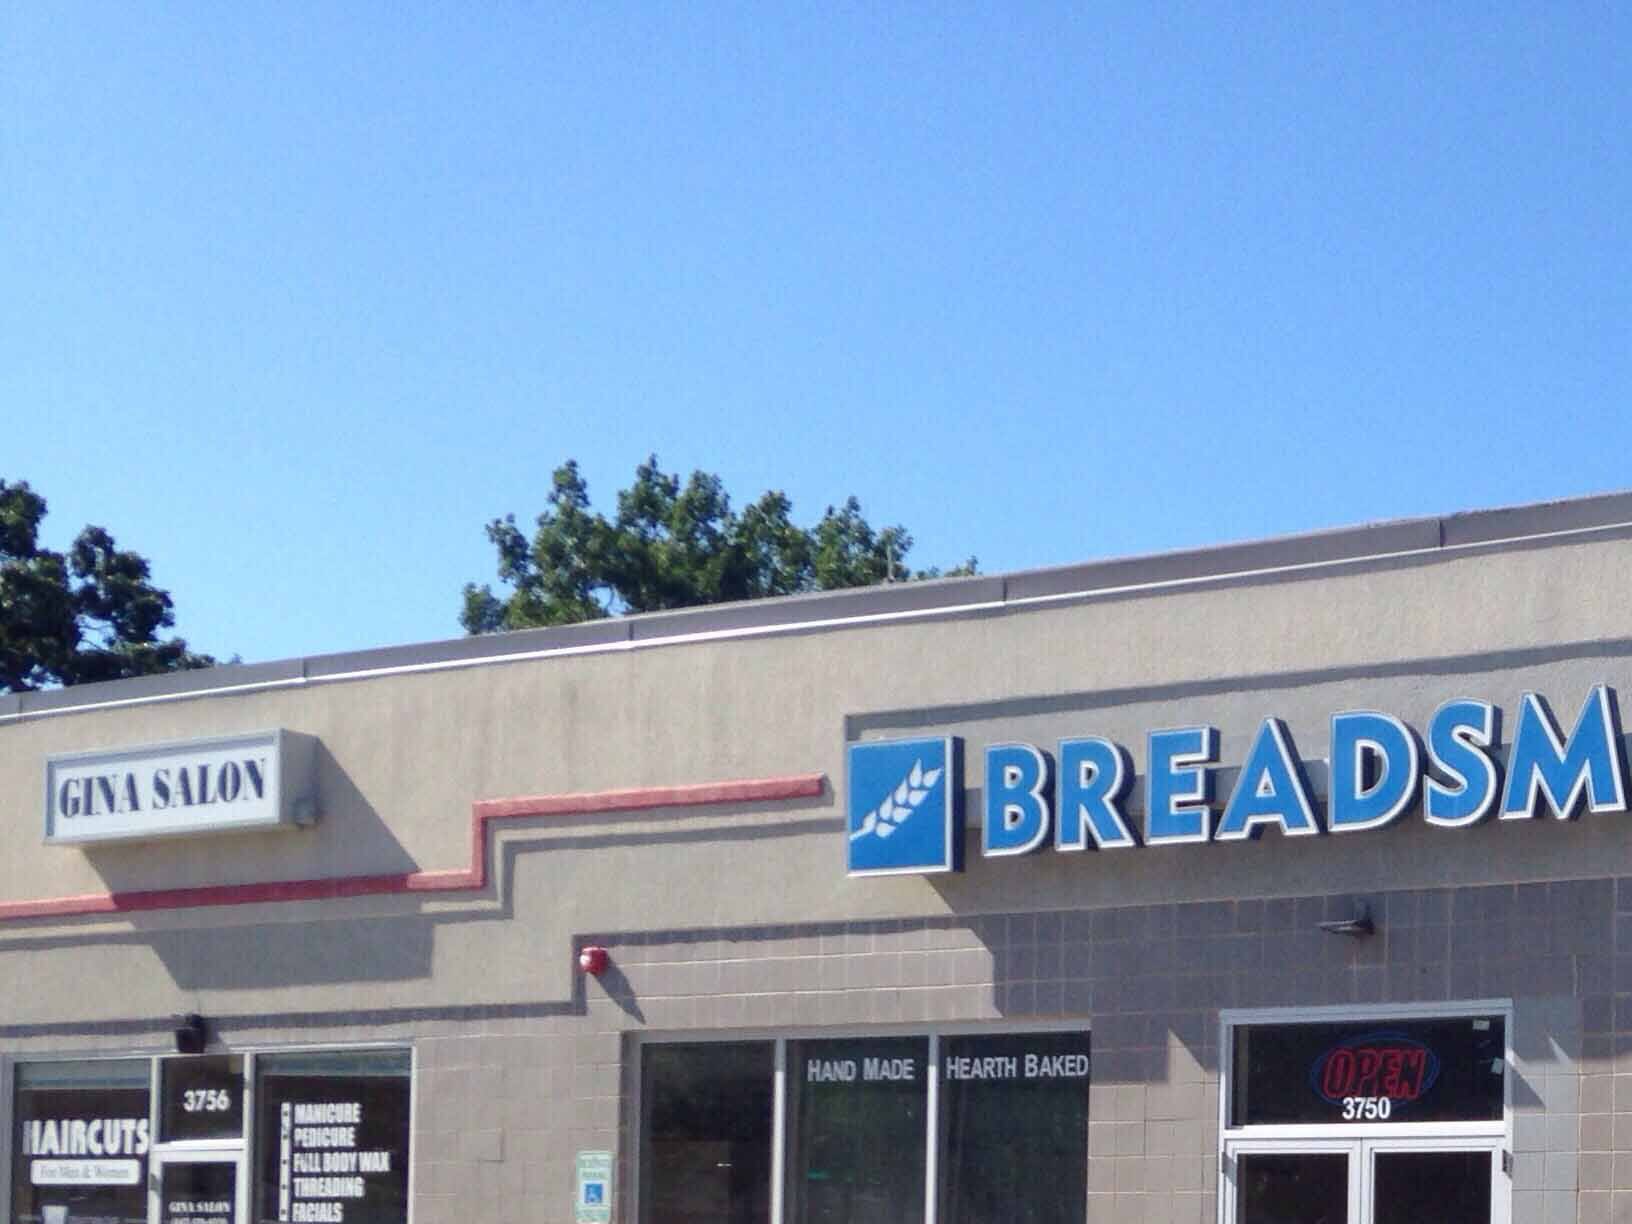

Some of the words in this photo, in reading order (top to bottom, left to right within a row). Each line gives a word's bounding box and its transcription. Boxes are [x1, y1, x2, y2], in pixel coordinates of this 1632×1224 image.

[59, 772, 140, 819] GINA
[152, 758, 266, 810] SALON
[807, 1059, 857, 1083] HAND
[863, 1057, 915, 1081] MADE
[946, 1056, 1017, 1080] HEARTH
[1024, 1054, 1090, 1078] BAKED
[1323, 1047, 1426, 1100] OPEN
[183, 1089, 231, 1113] 3756
[1341, 1096, 1391, 1119] 3750
[294, 1102, 362, 1124] MANICURE
[22, 1118, 149, 1155] HAIRCUTS
[293, 1126, 356, 1148] PEDICURE
[322, 1151, 358, 1173] BODY
[358, 1151, 391, 1172] WAX
[293, 1176, 366, 1198] THREADING
[291, 1202, 344, 1223] FACIALS
